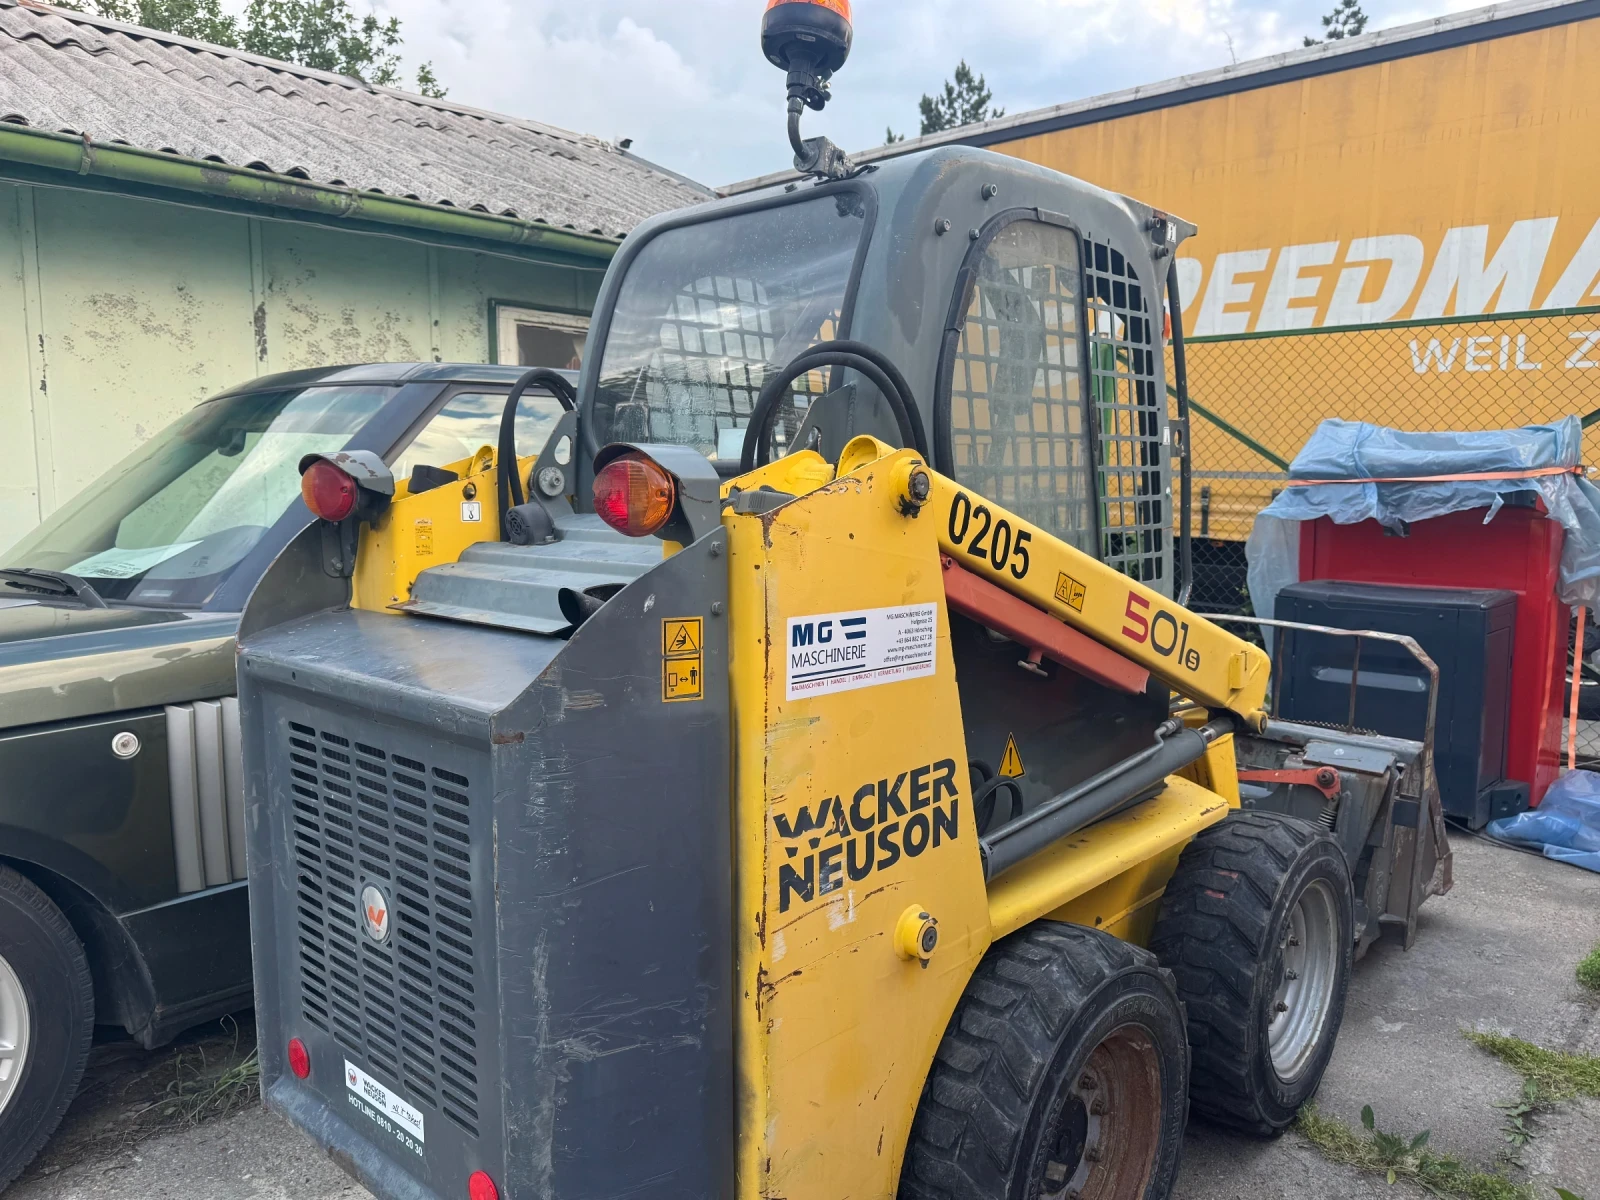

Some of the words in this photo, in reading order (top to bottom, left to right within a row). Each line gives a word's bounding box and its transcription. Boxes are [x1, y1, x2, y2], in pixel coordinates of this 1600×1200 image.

[1408, 333, 1543, 374] WEIL
[948, 490, 1032, 580] 0205
[792, 620, 833, 648] MG
[791, 643, 867, 669] MASCHINERIE
[772, 757, 960, 859] WACKER
[778, 797, 960, 914] NEUSON
[362, 1077, 387, 1100] WACKER
[363, 1085, 388, 1109] NEUSON
[348, 1093, 376, 1122] HOTLINE
[376, 1114, 392, 1133] 0810
[396, 1129, 405, 1143] 20
[405, 1135, 414, 1150] 20
[414, 1142, 423, 1157] 30
